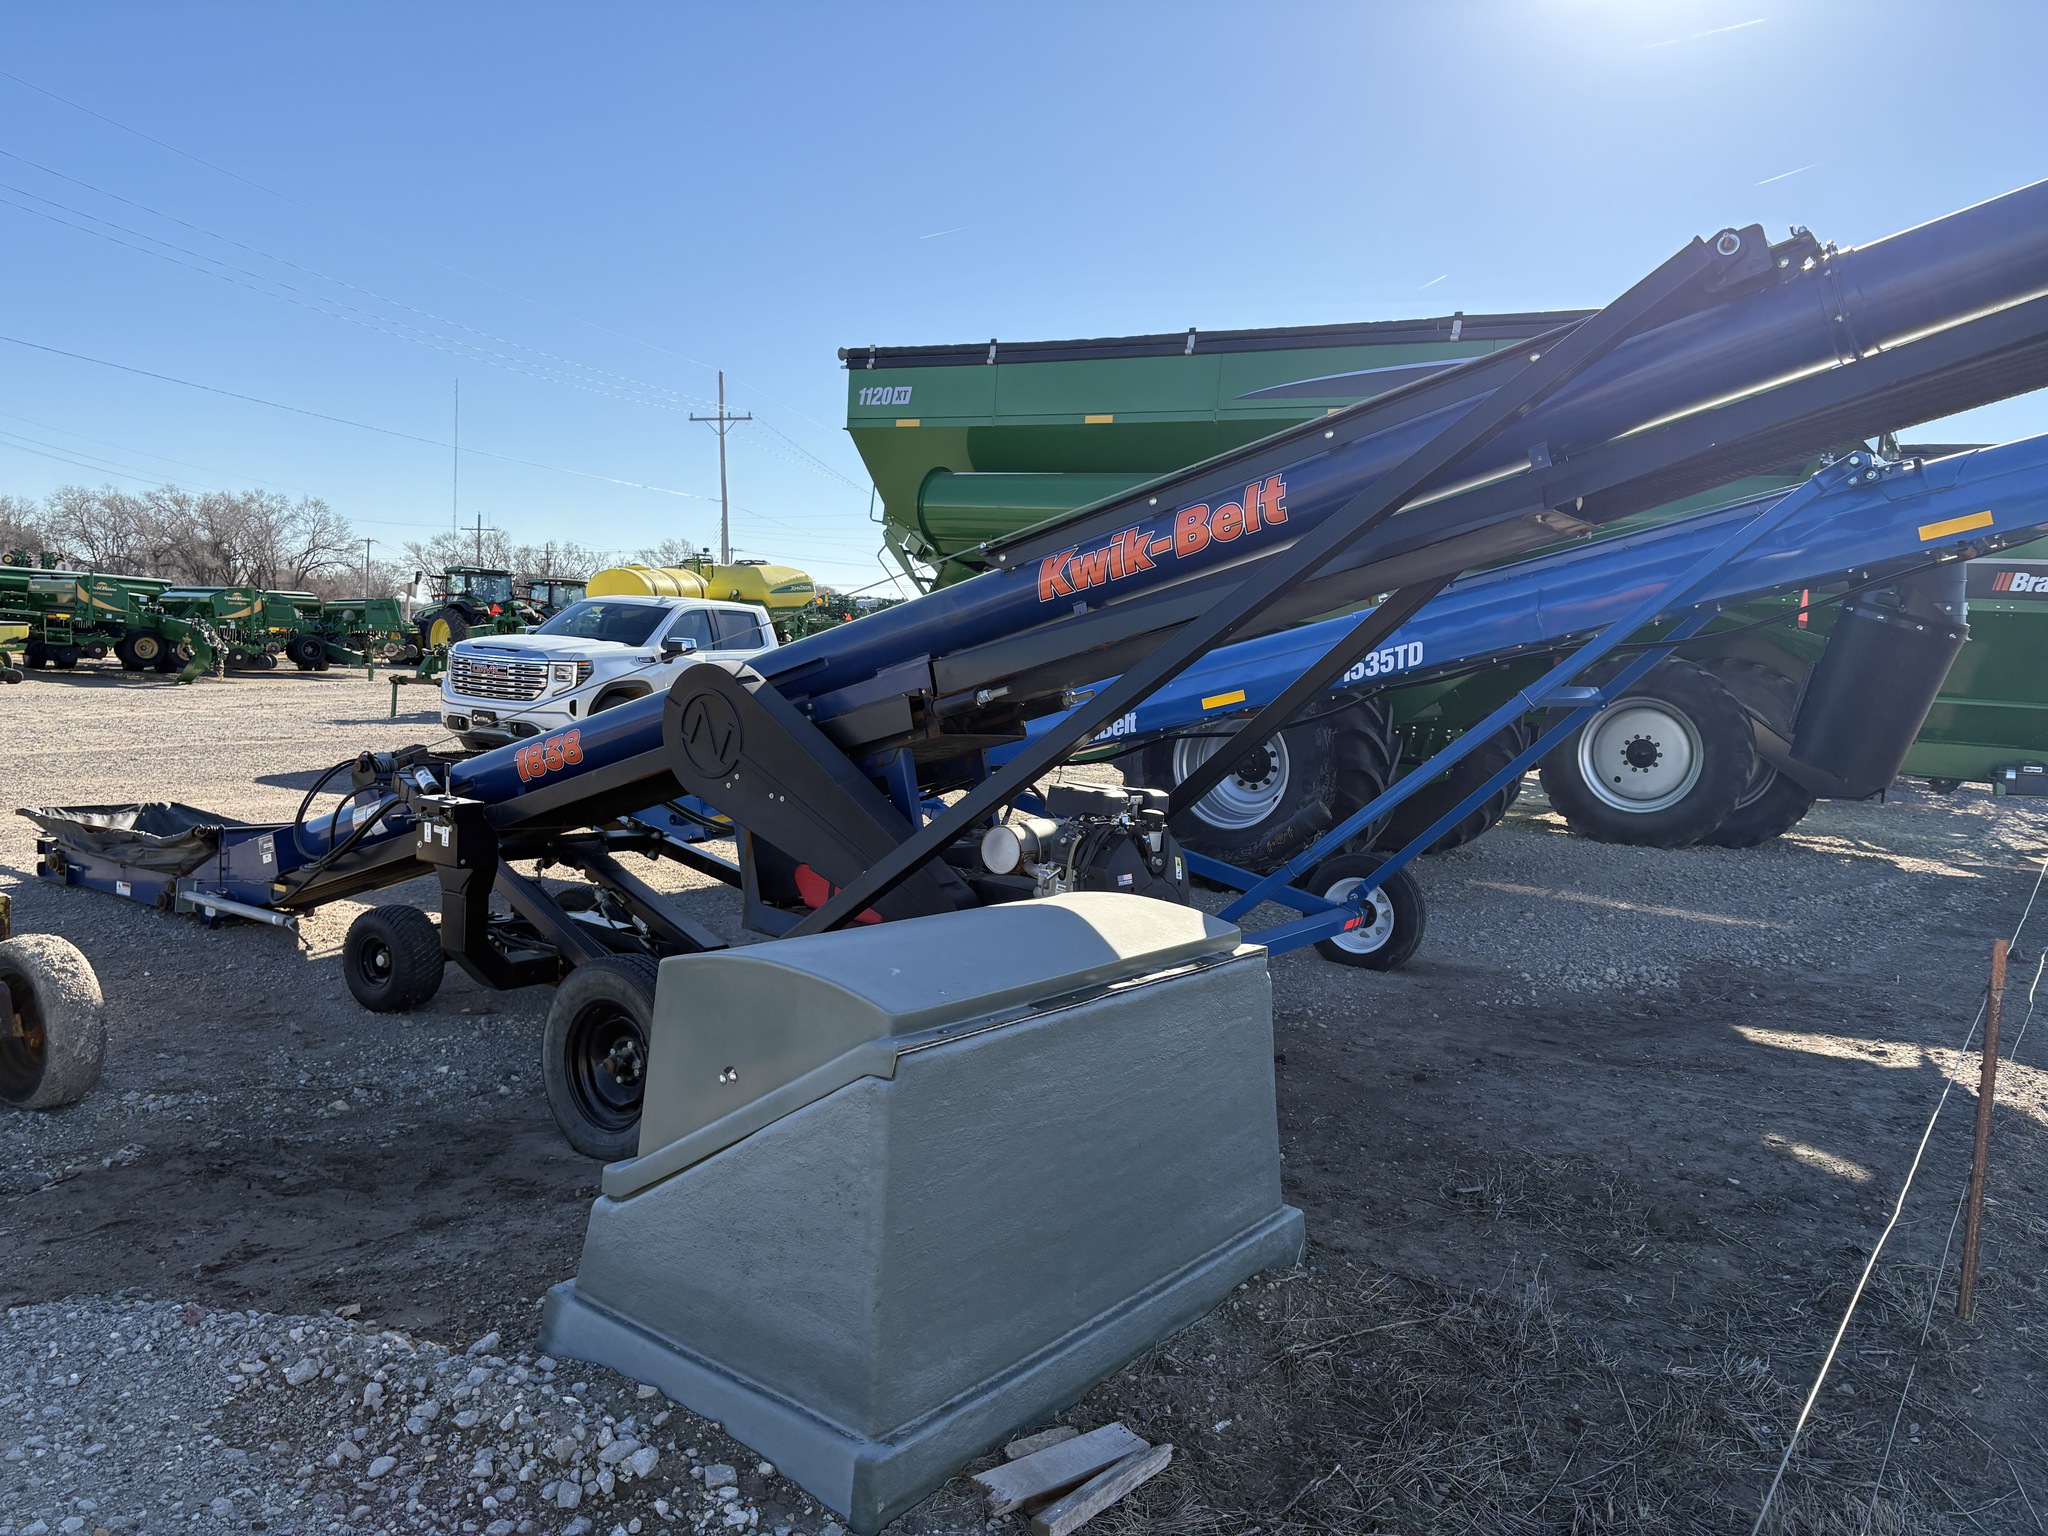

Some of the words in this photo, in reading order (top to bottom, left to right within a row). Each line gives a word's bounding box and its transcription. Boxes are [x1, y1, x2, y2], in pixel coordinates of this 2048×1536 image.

[1038, 473, 1288, 603] Kwik-Belt
[471, 664, 507, 676] GMC
[514, 728, 583, 783] 1838
